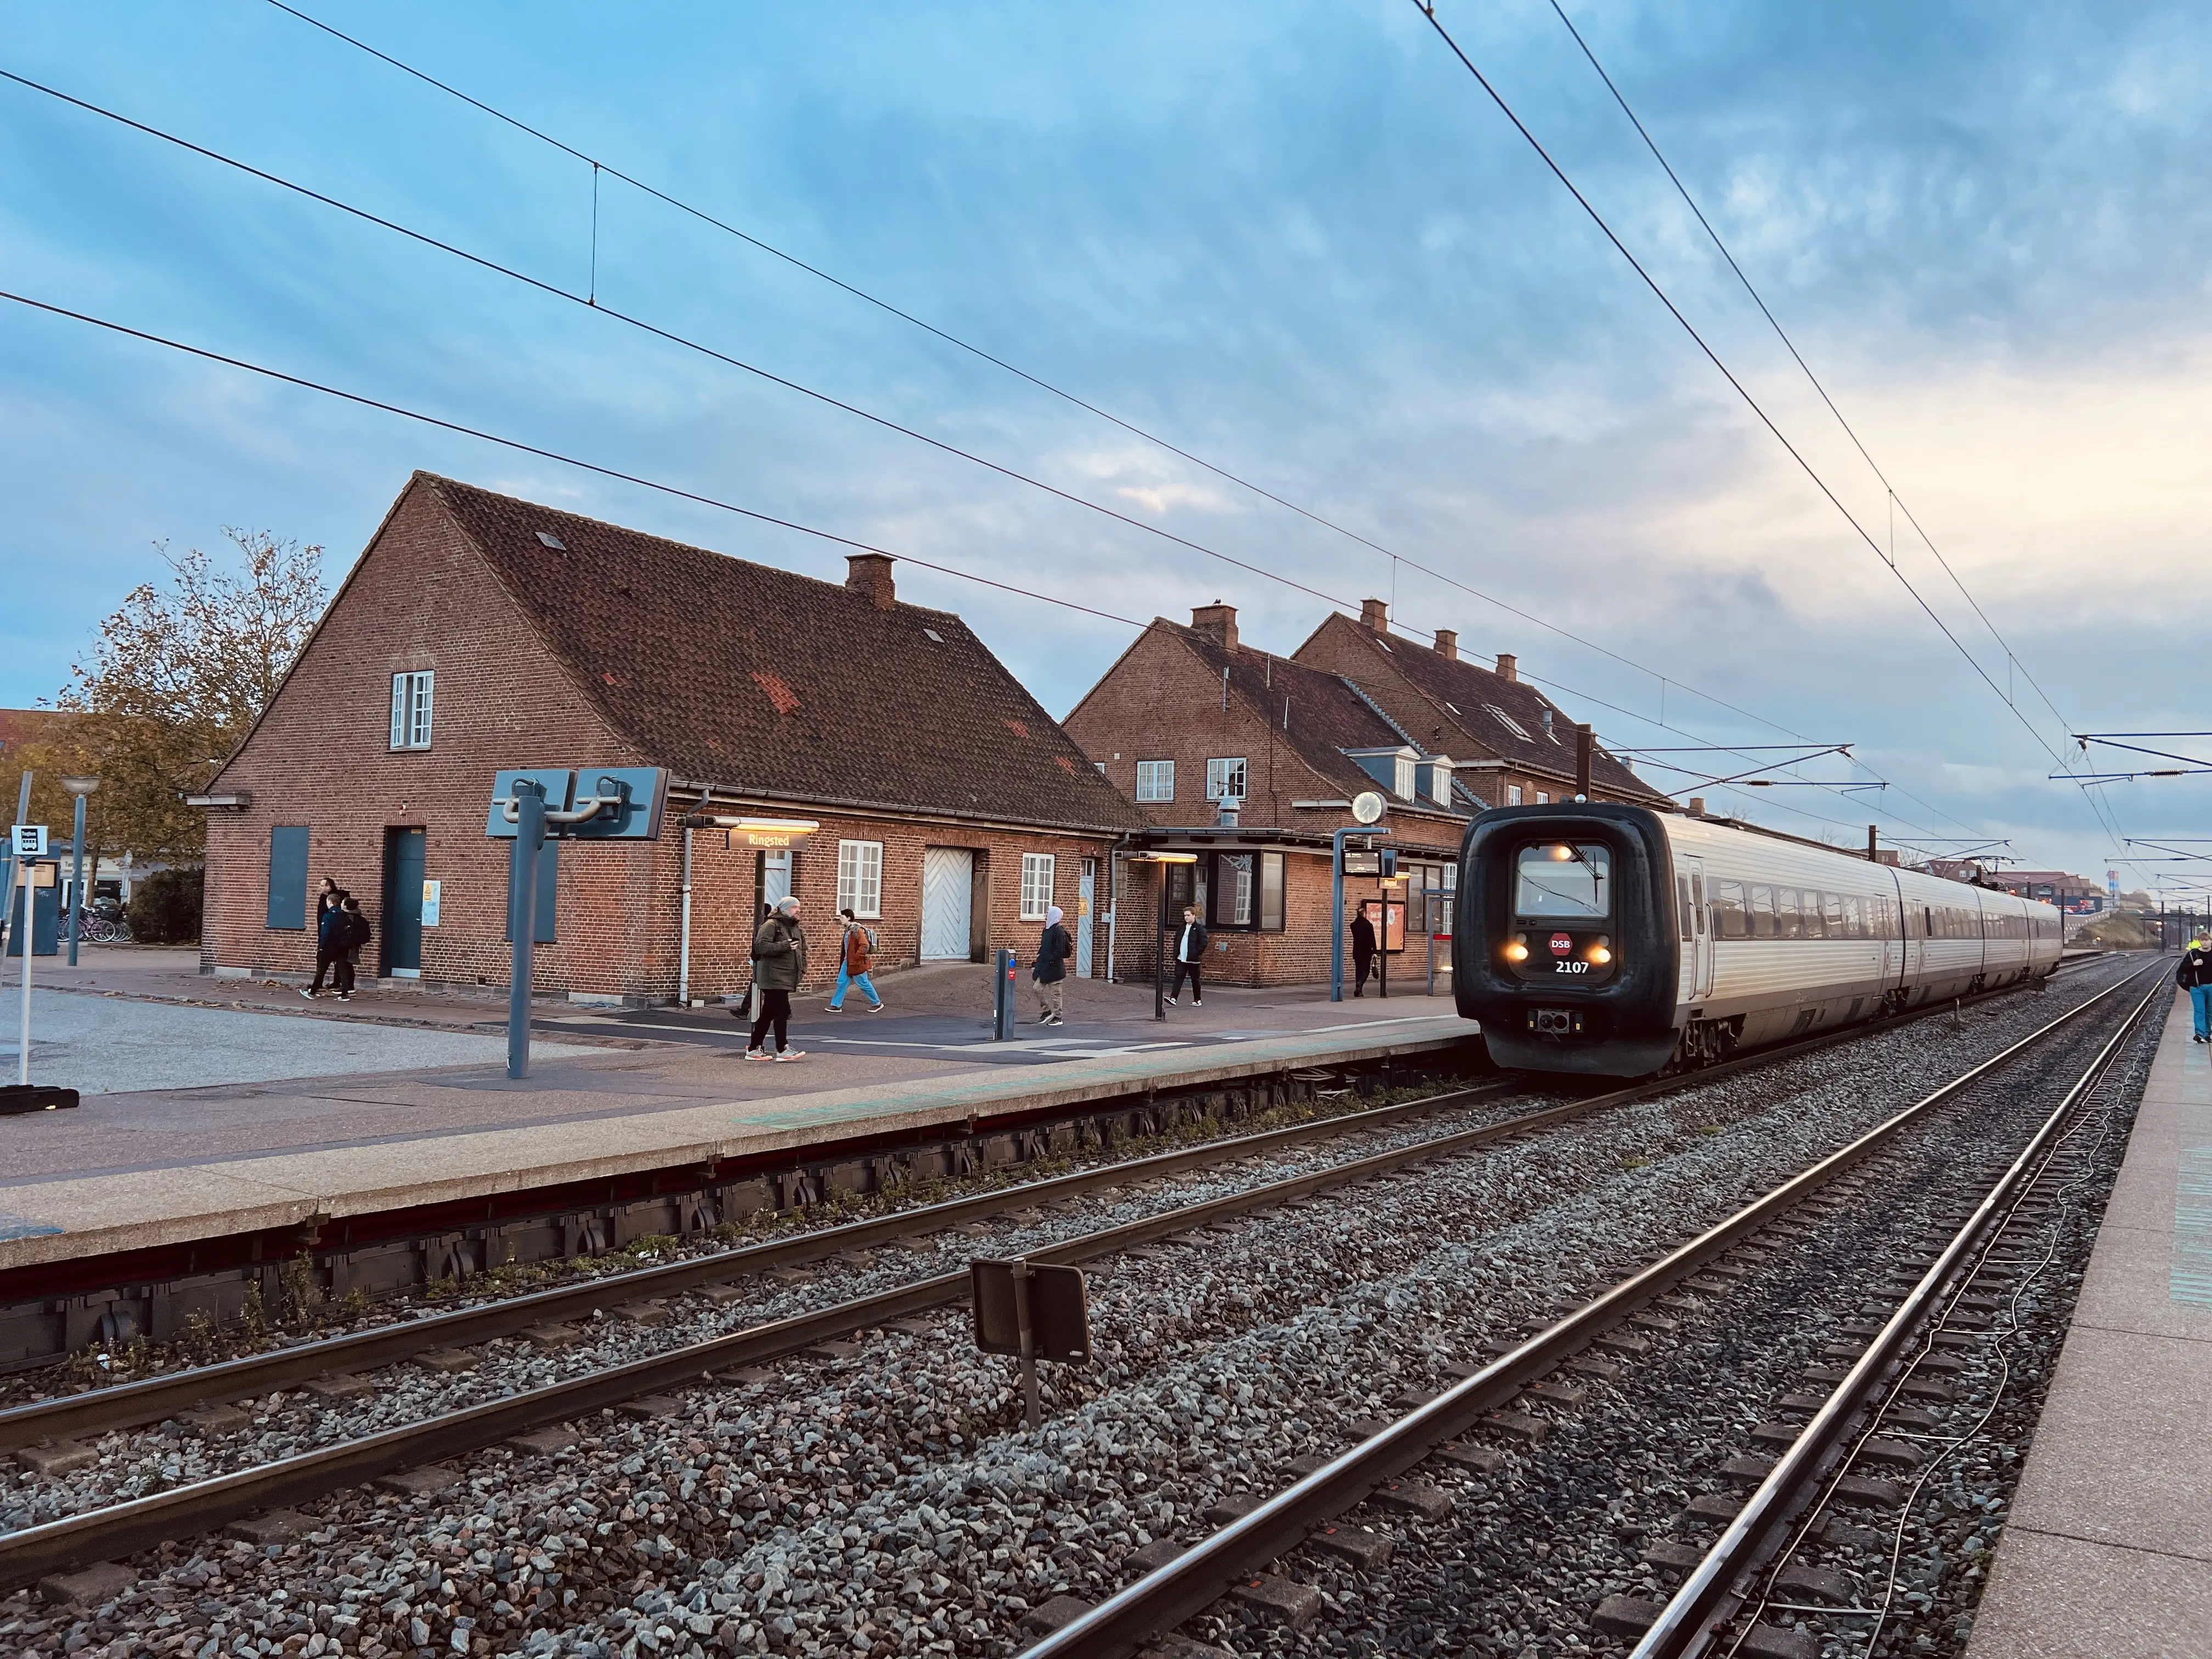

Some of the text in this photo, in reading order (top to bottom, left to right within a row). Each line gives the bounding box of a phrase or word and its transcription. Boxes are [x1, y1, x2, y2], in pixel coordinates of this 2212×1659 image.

[748, 833, 790, 848] Ringsted
[1551, 940, 1571, 949] DSB
[1556, 961, 1589, 974] 2107
